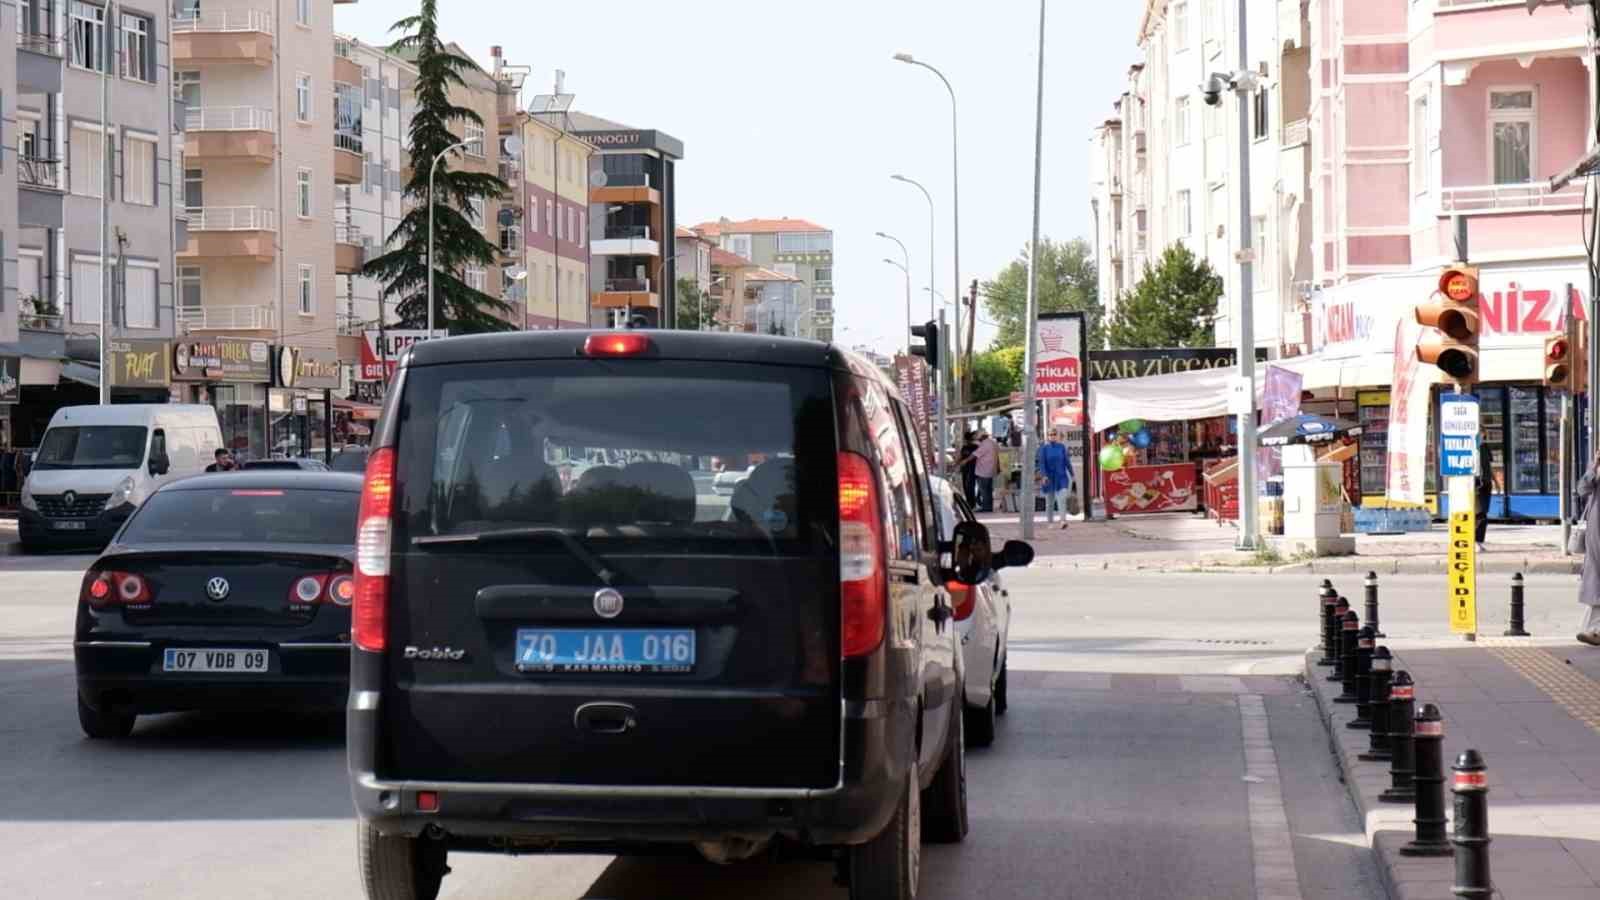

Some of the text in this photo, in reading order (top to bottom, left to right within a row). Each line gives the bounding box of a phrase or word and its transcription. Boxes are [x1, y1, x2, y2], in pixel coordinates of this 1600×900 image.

[522, 635, 689, 661] 70 JAA 016
[176, 652, 264, 669] 07 VDB 09
